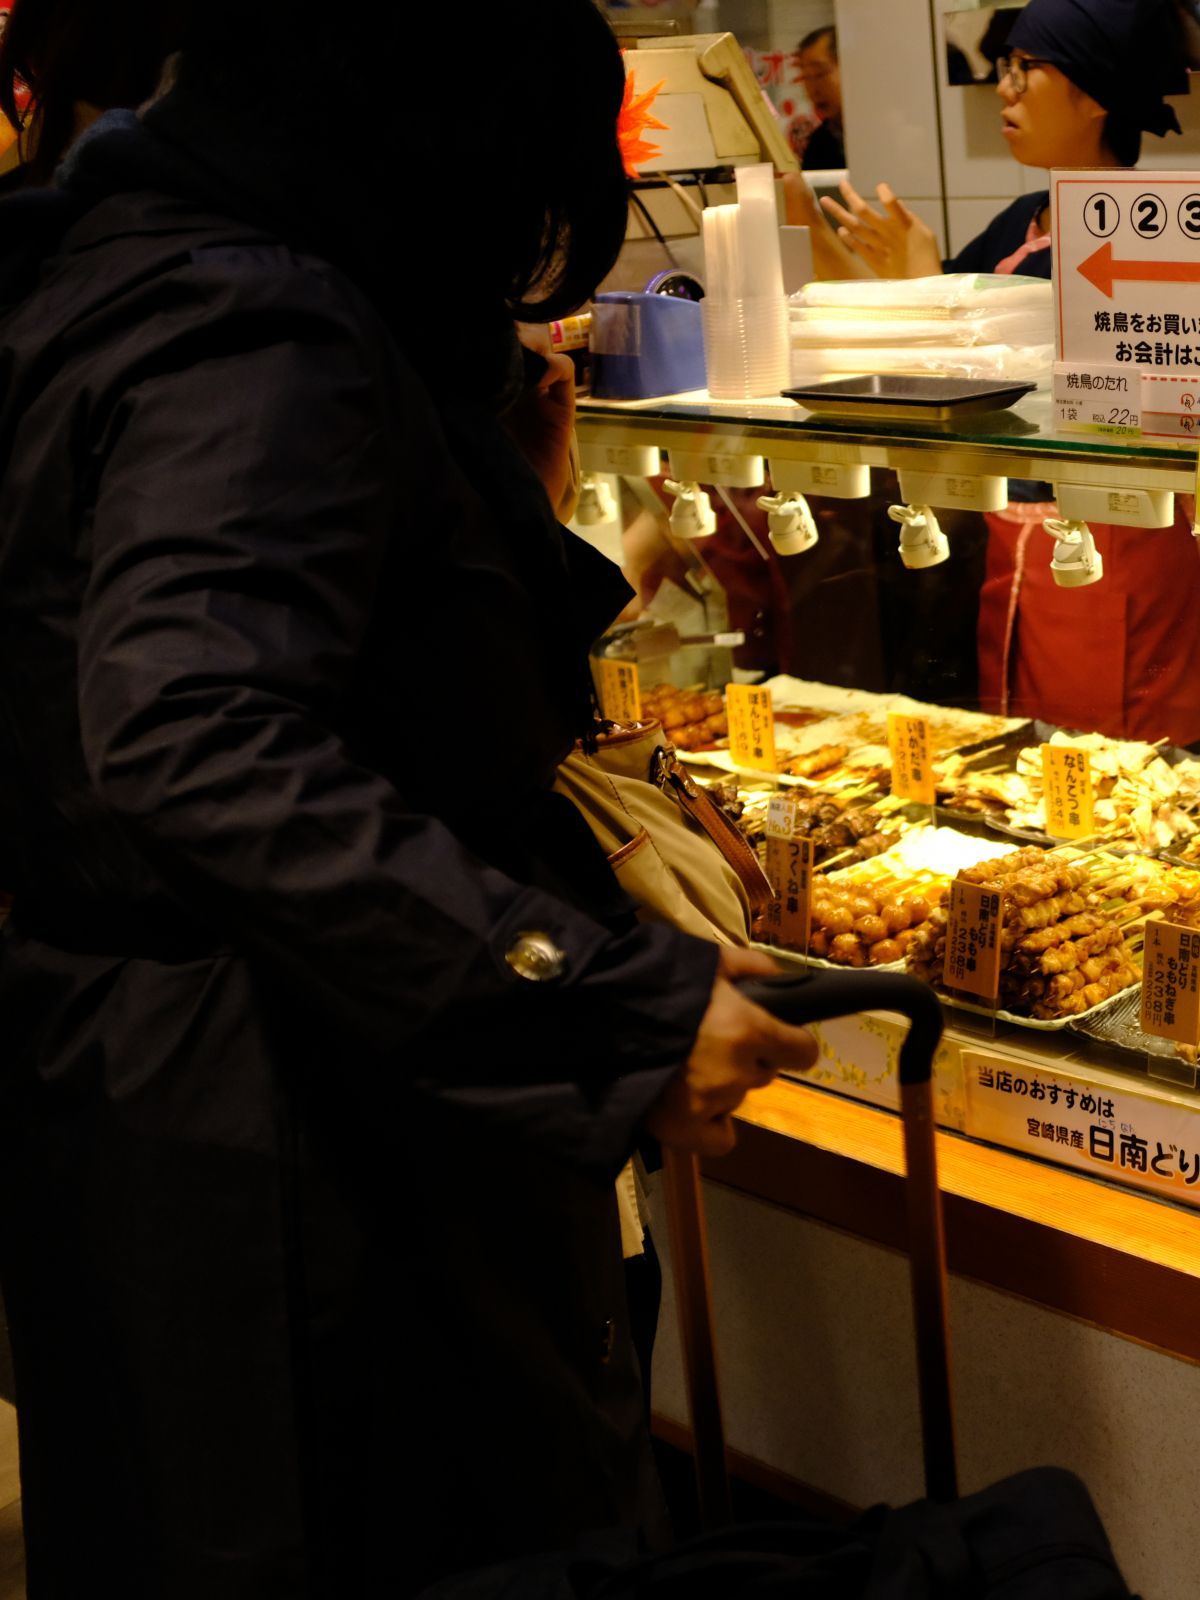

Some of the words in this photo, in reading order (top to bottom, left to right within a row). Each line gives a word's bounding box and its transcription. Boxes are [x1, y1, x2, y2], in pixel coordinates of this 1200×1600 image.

[1066, 373, 1129, 392] 焼鳥のたれ
[1060, 409, 1078, 421] 1袋
[1092, 414, 1106, 423] 税込
[1108, 408, 1139, 426] 22円
[1064, 753, 1080, 826] なんこつ串
[1178, 933, 1191, 990] 日南どり
[1153, 970, 1165, 1027] 238円
[1164, 957, 1178, 1025] ももねぎ串
[978, 1067, 1115, 1119] 当店のおすすめは
[1027, 1118, 1085, 1150] 宮崎県産
[1089, 1125, 1200, 1185] 日南どり
